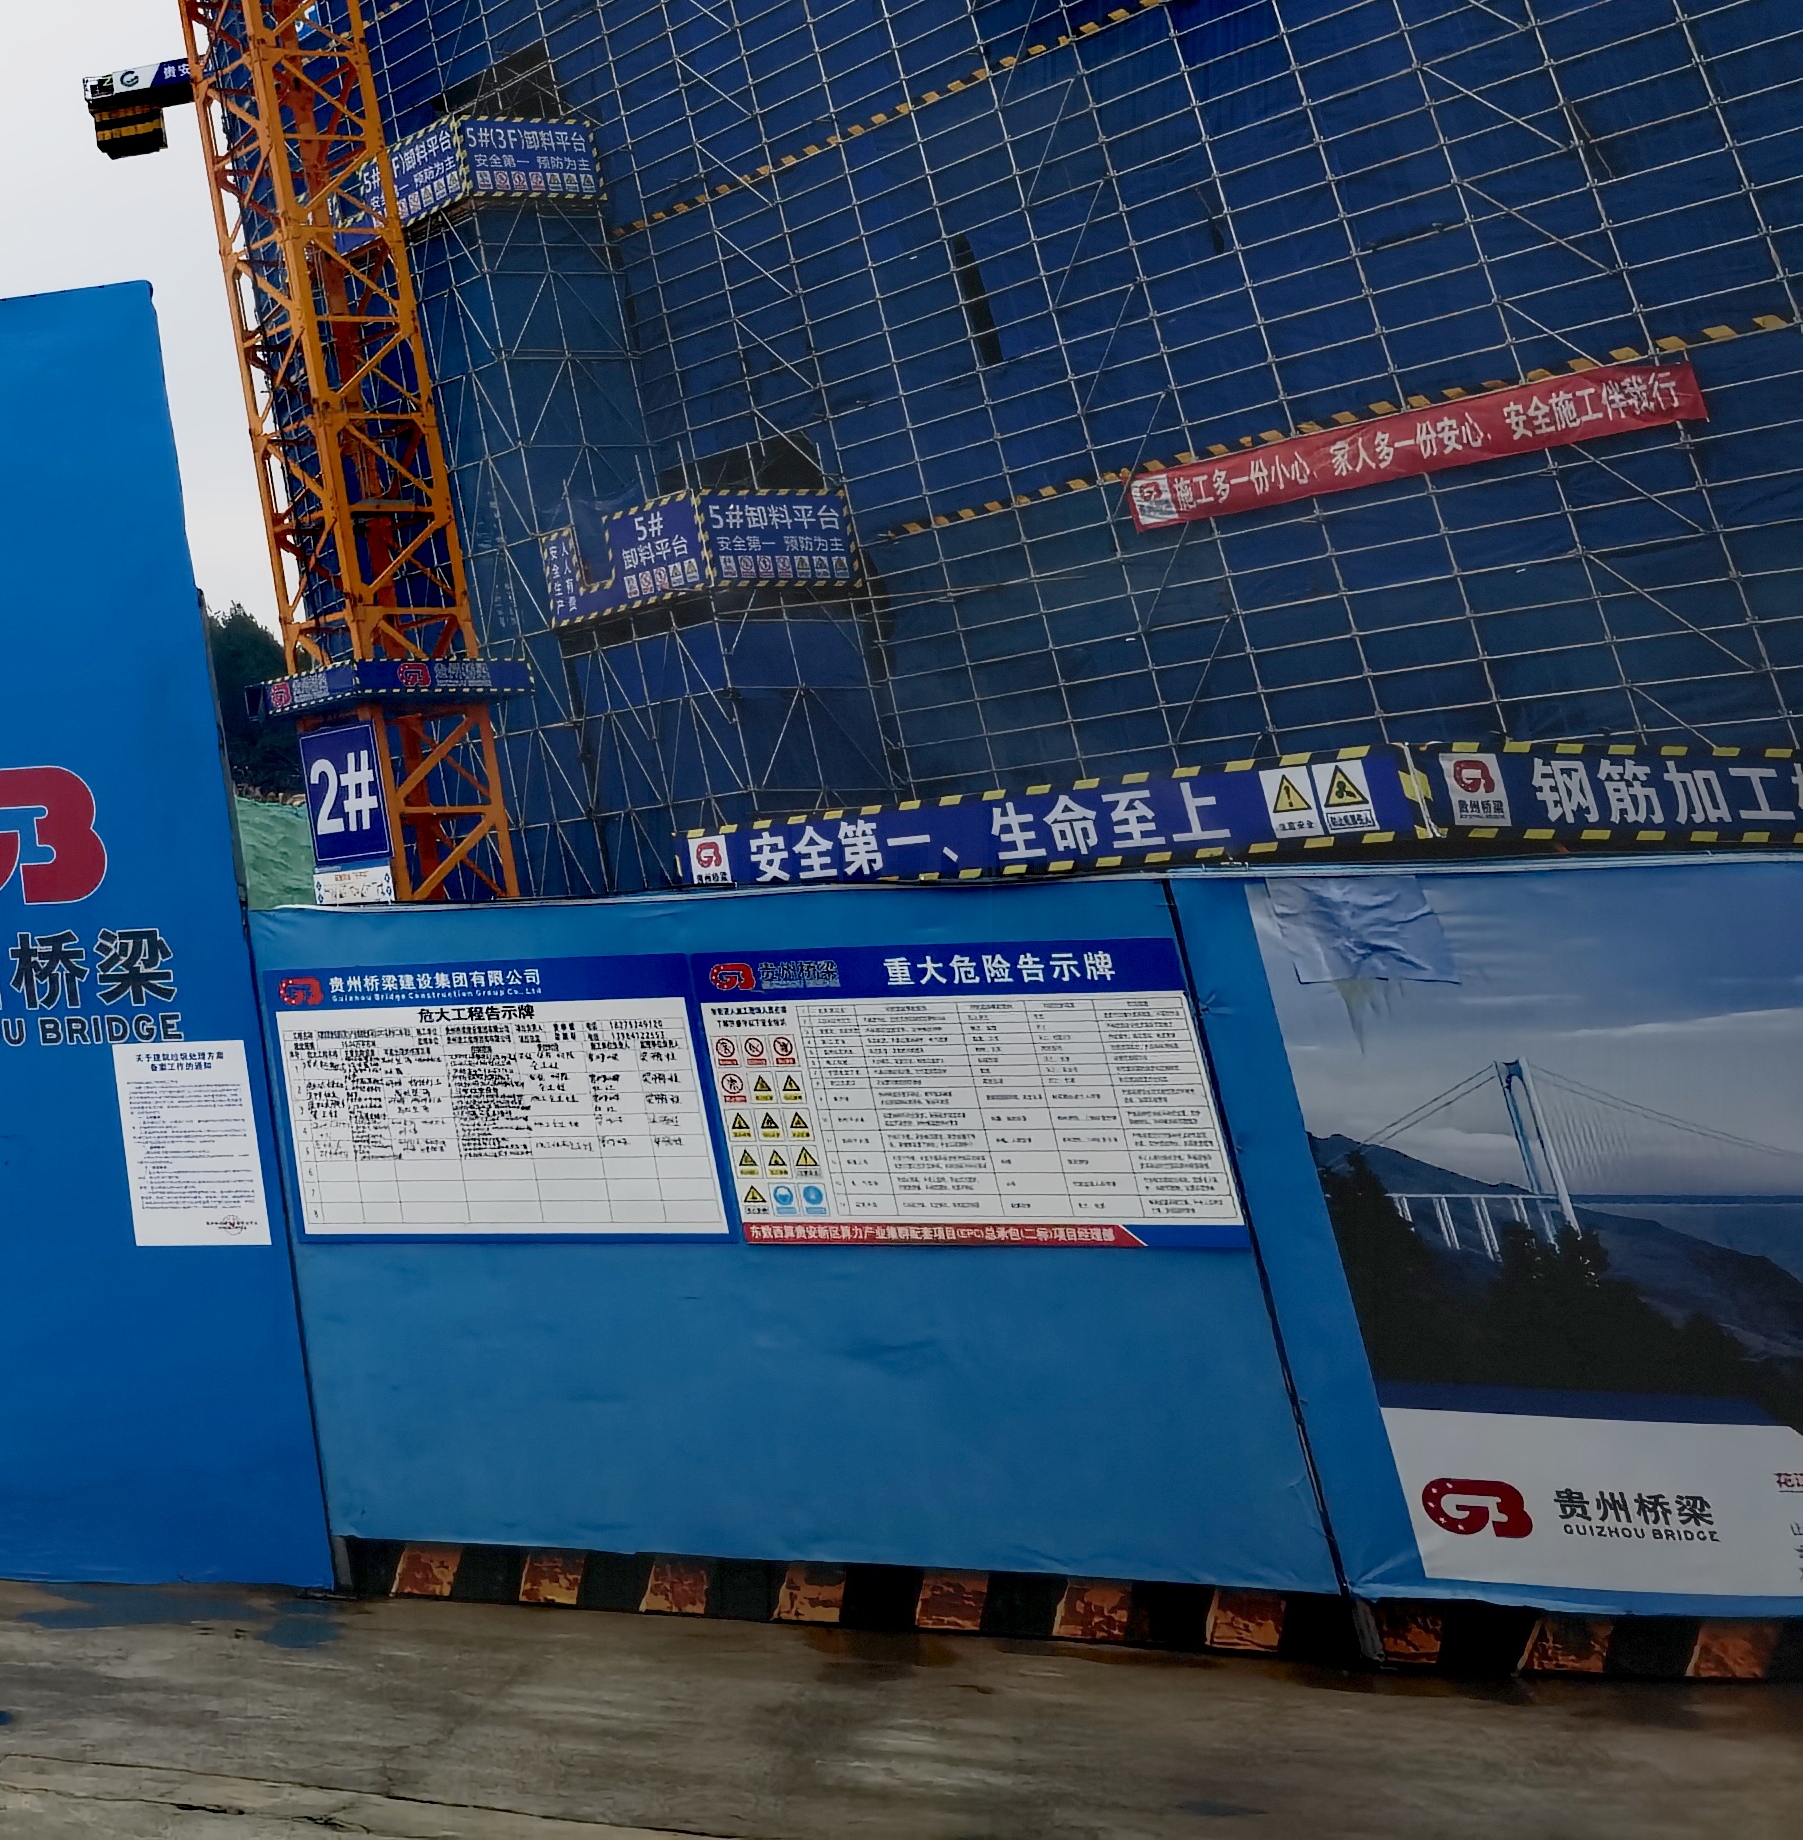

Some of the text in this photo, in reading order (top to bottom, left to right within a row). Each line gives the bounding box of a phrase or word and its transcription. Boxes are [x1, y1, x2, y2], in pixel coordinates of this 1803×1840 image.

[466, 127, 587, 153] 5#(3F)卸料平台
[363, 130, 453, 193] 5#F)卸料平台
[474, 154, 592, 171] 安全第一 预防为主
[634, 511, 663, 540] 5#
[709, 504, 840, 530] 5#卸料平台
[622, 535, 688, 569] 卸料平台
[716, 536, 844, 552] 安全第一 预防为主
[310, 750, 378, 836] 2#
[1531, 757, 1803, 825] 钢筋加工
[1457, 798, 1505, 814] 贵州桥梁
[750, 782, 1231, 882] 安全第一、生命至上
[329, 968, 540, 993] 贵州桥梁建设集团有限公司
[759, 960, 838, 981] 贵州桥梁
[883, 950, 1116, 986] 重大危险告示牌
[374, 992, 406, 1003] Bridge
[408, 991, 473, 1000] Construction
[476, 989, 505, 998] Group
[418, 1004, 535, 1023] 危大工程告示牌
[40, 1012, 185, 1046] BRIDGE
[1421, 1477, 1533, 1538] GB
[1554, 1487, 1714, 1527] 贵州桥梁
[1564, 1524, 1721, 1542] GUIZHOU BRIDGE
